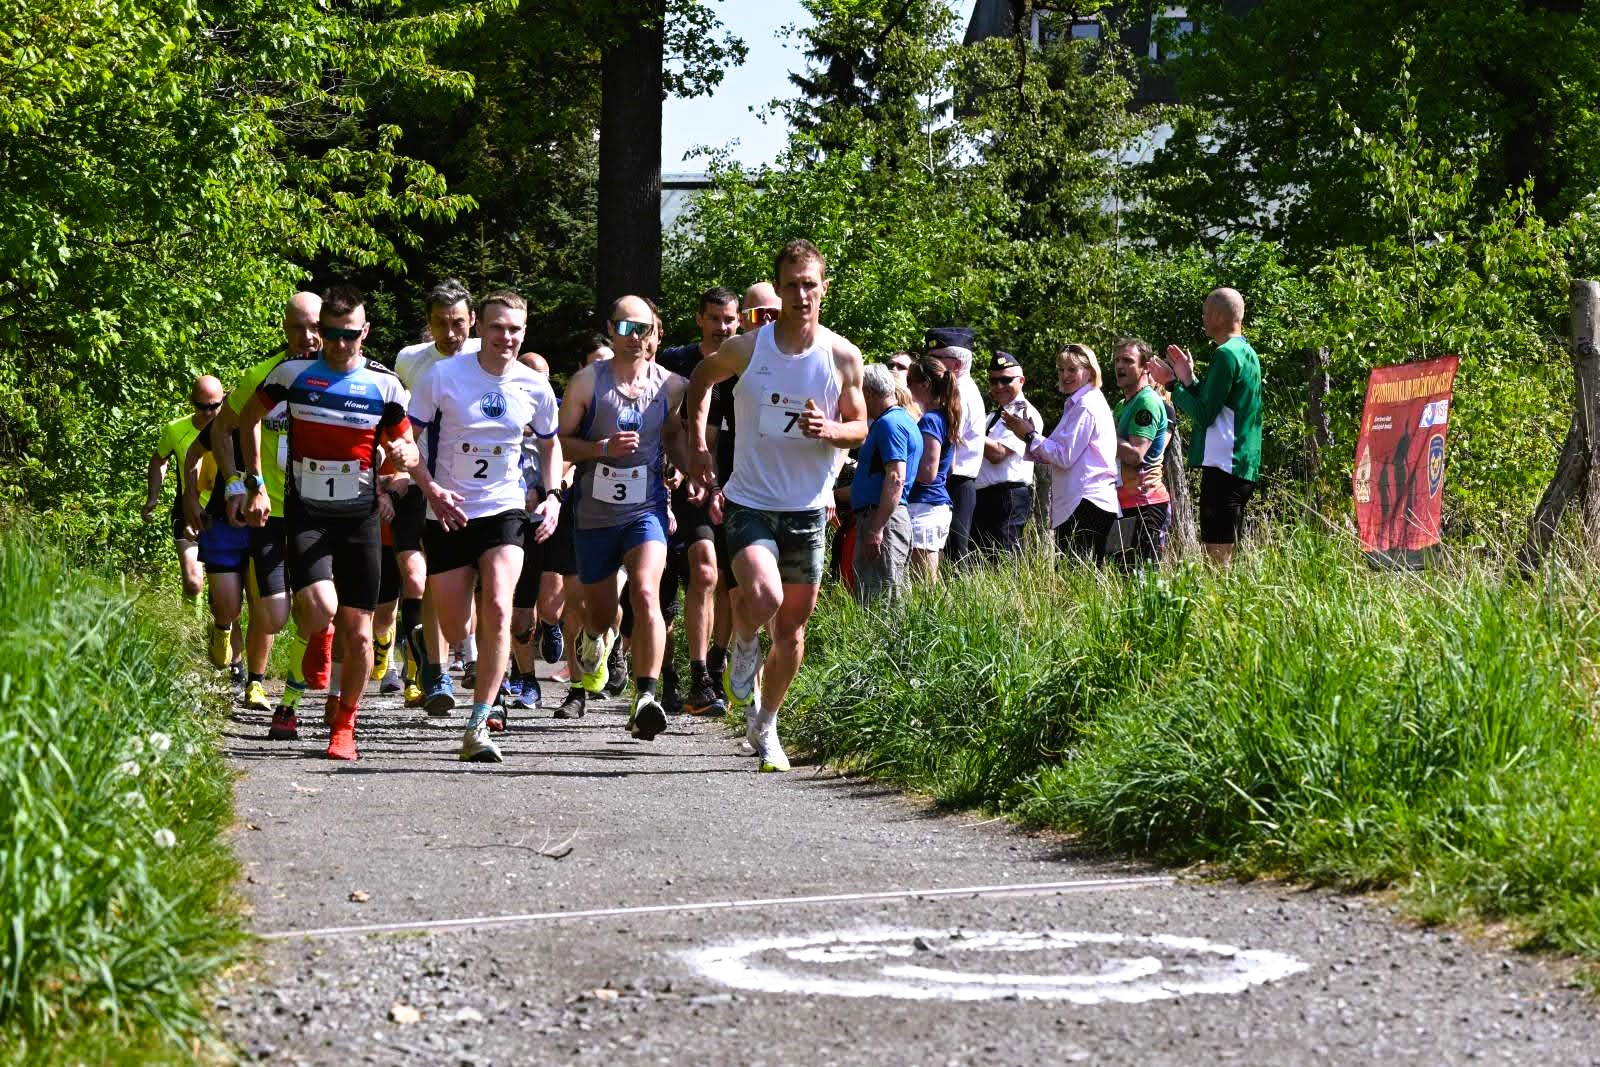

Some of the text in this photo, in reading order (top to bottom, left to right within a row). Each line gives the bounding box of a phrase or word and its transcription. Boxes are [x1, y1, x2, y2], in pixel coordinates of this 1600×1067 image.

[784, 411, 800, 433] 7
[473, 459, 489, 479] 2
[325, 478, 335, 498] 1
[612, 483, 627, 501] 3
